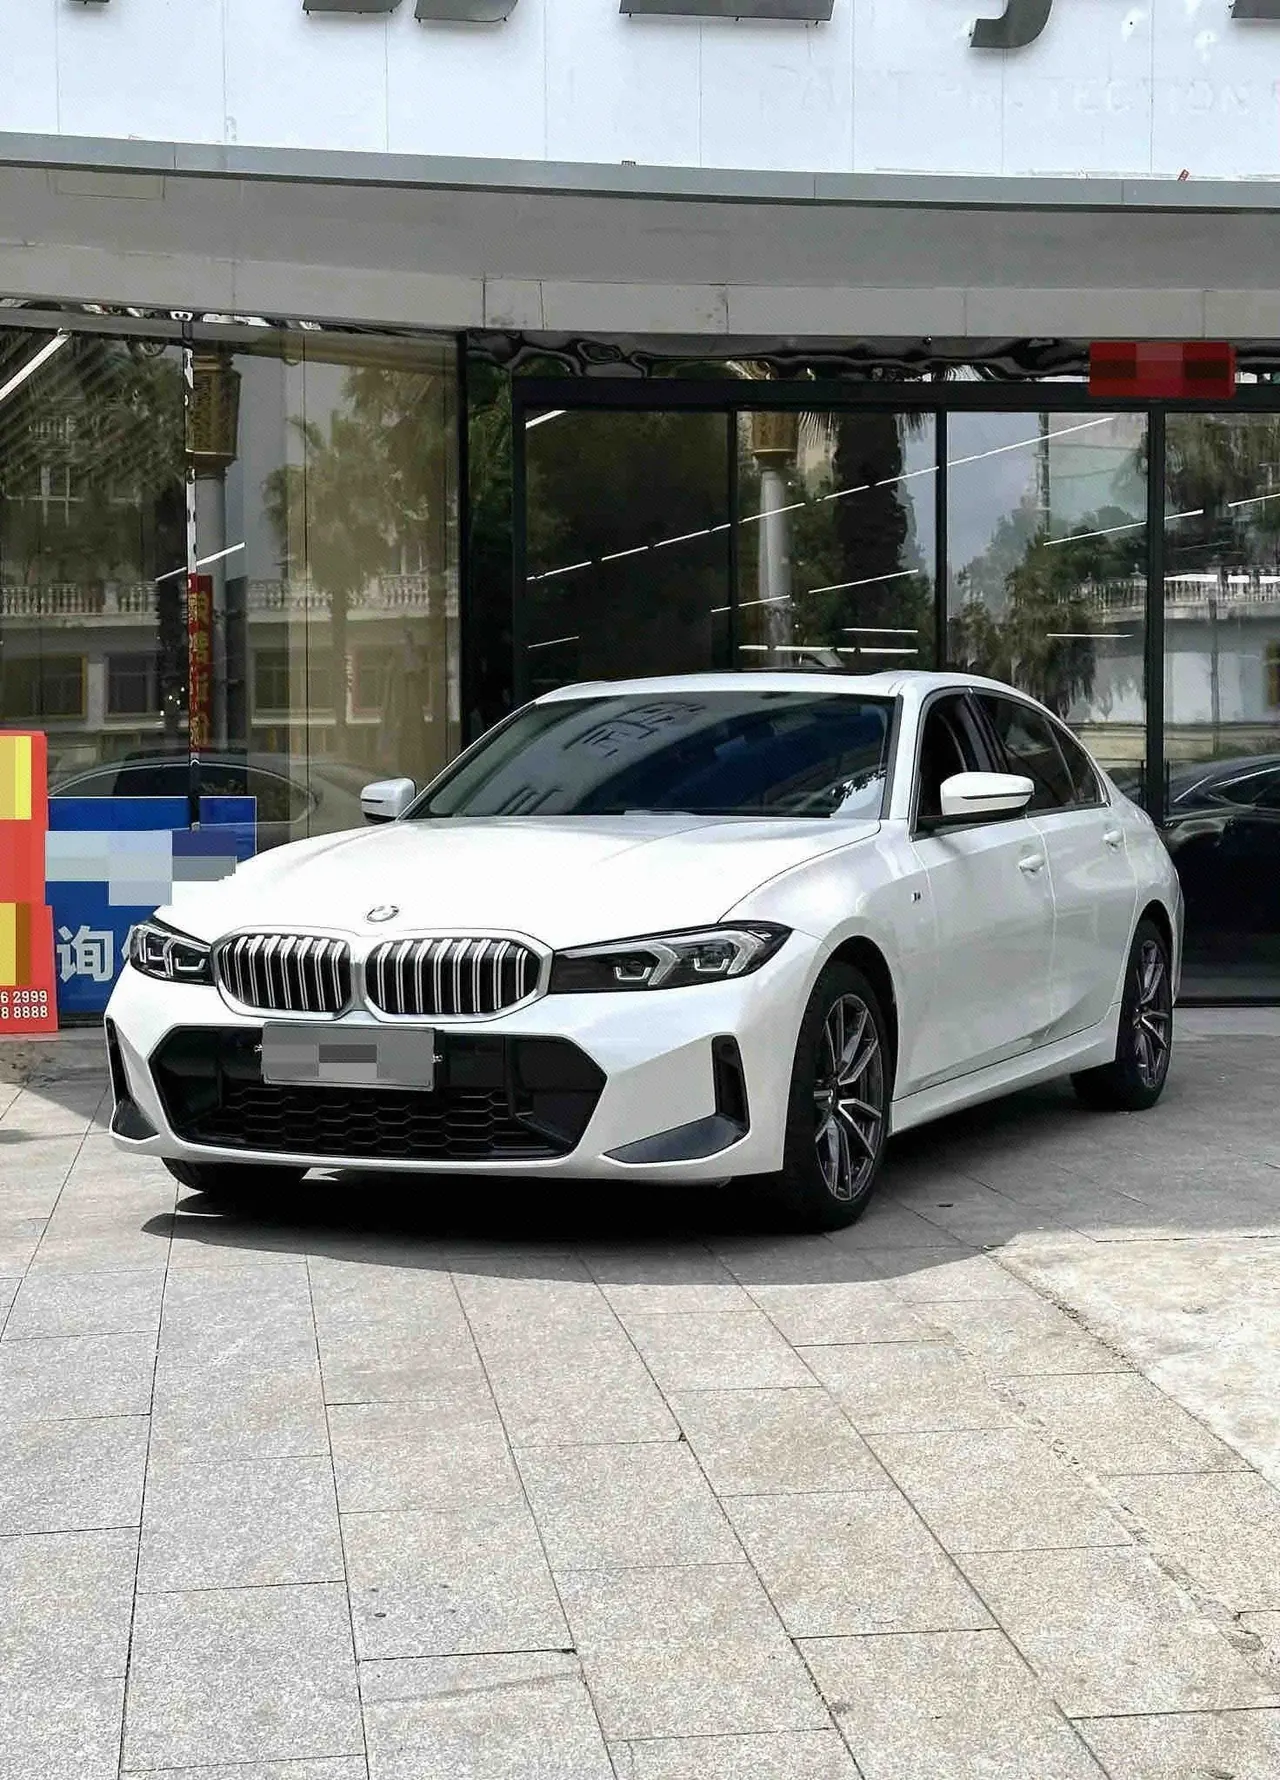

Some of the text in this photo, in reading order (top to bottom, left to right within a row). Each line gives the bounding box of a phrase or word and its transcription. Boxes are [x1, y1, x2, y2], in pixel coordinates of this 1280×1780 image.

[56, 925, 134, 982] 询
[13, 990, 48, 1004] 2999
[13, 1005, 48, 1019] 8888
